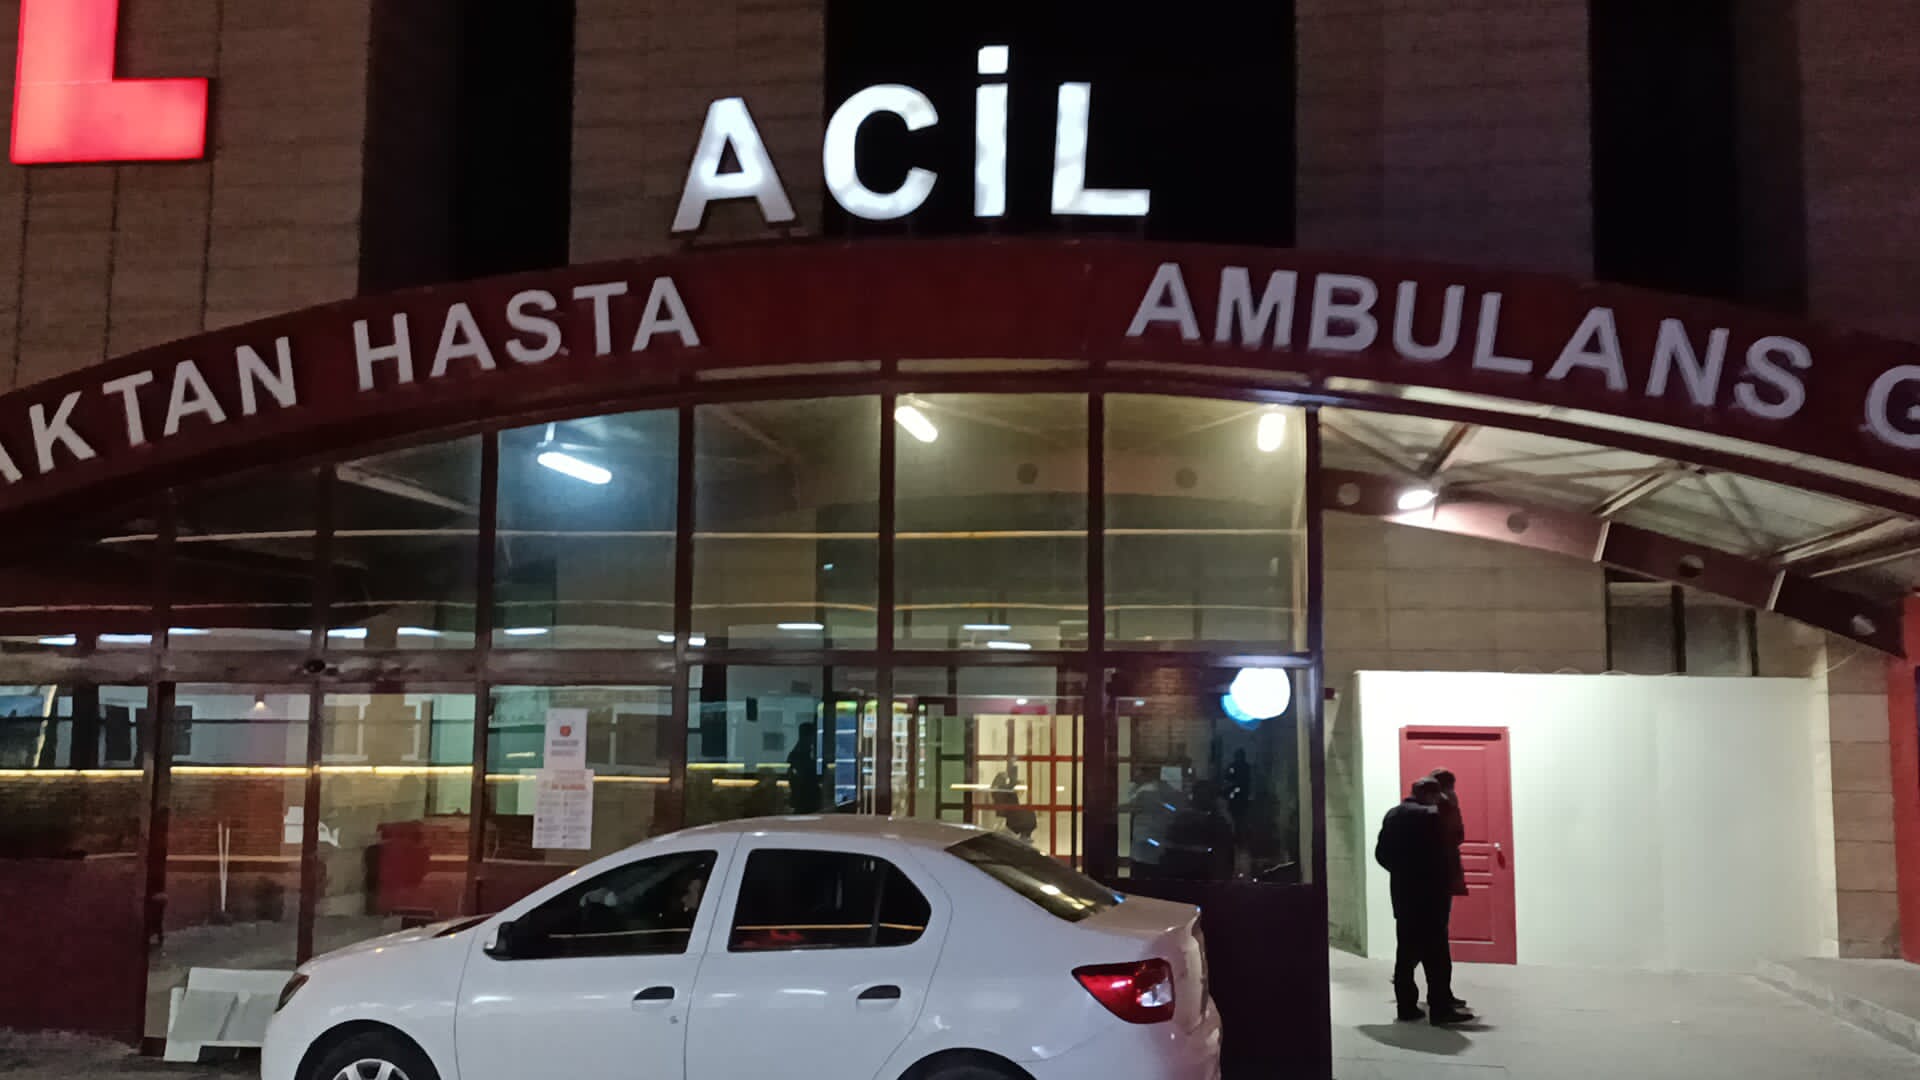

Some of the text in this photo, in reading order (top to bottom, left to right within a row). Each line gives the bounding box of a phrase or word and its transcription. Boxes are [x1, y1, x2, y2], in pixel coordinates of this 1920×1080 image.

[672, 45, 1151, 231] ACİL
[353, 277, 701, 391] HASTA
[1126, 262, 1812, 419] AMBULANS
